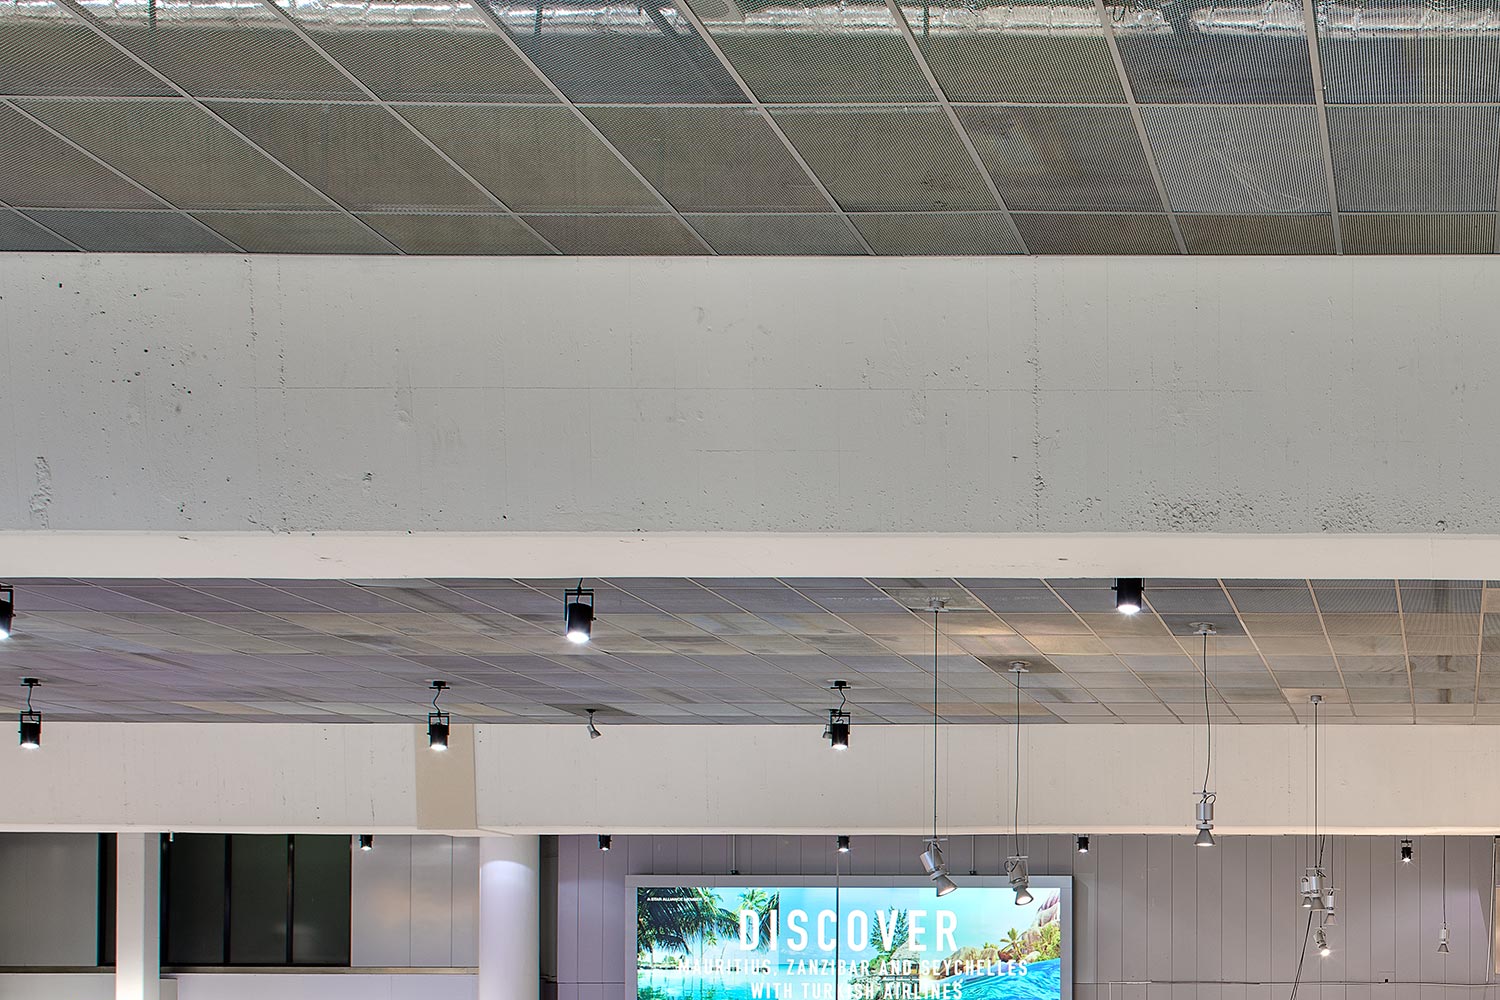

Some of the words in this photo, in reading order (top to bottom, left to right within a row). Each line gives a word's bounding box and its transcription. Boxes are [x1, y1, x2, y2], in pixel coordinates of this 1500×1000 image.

[739, 909, 958, 952] DISCOVER
[679, 959, 778, 977] MAURITIUS,
[787, 959, 871, 977] ZANZIBAR
[881, 959, 912, 977] AND
[922, 959, 1028, 977] SEYCHELLES
[751, 983, 793, 1000] WITH
[802, 983, 874, 1000] TURKISH
[884, 983, 963, 1000] AIRLINES
